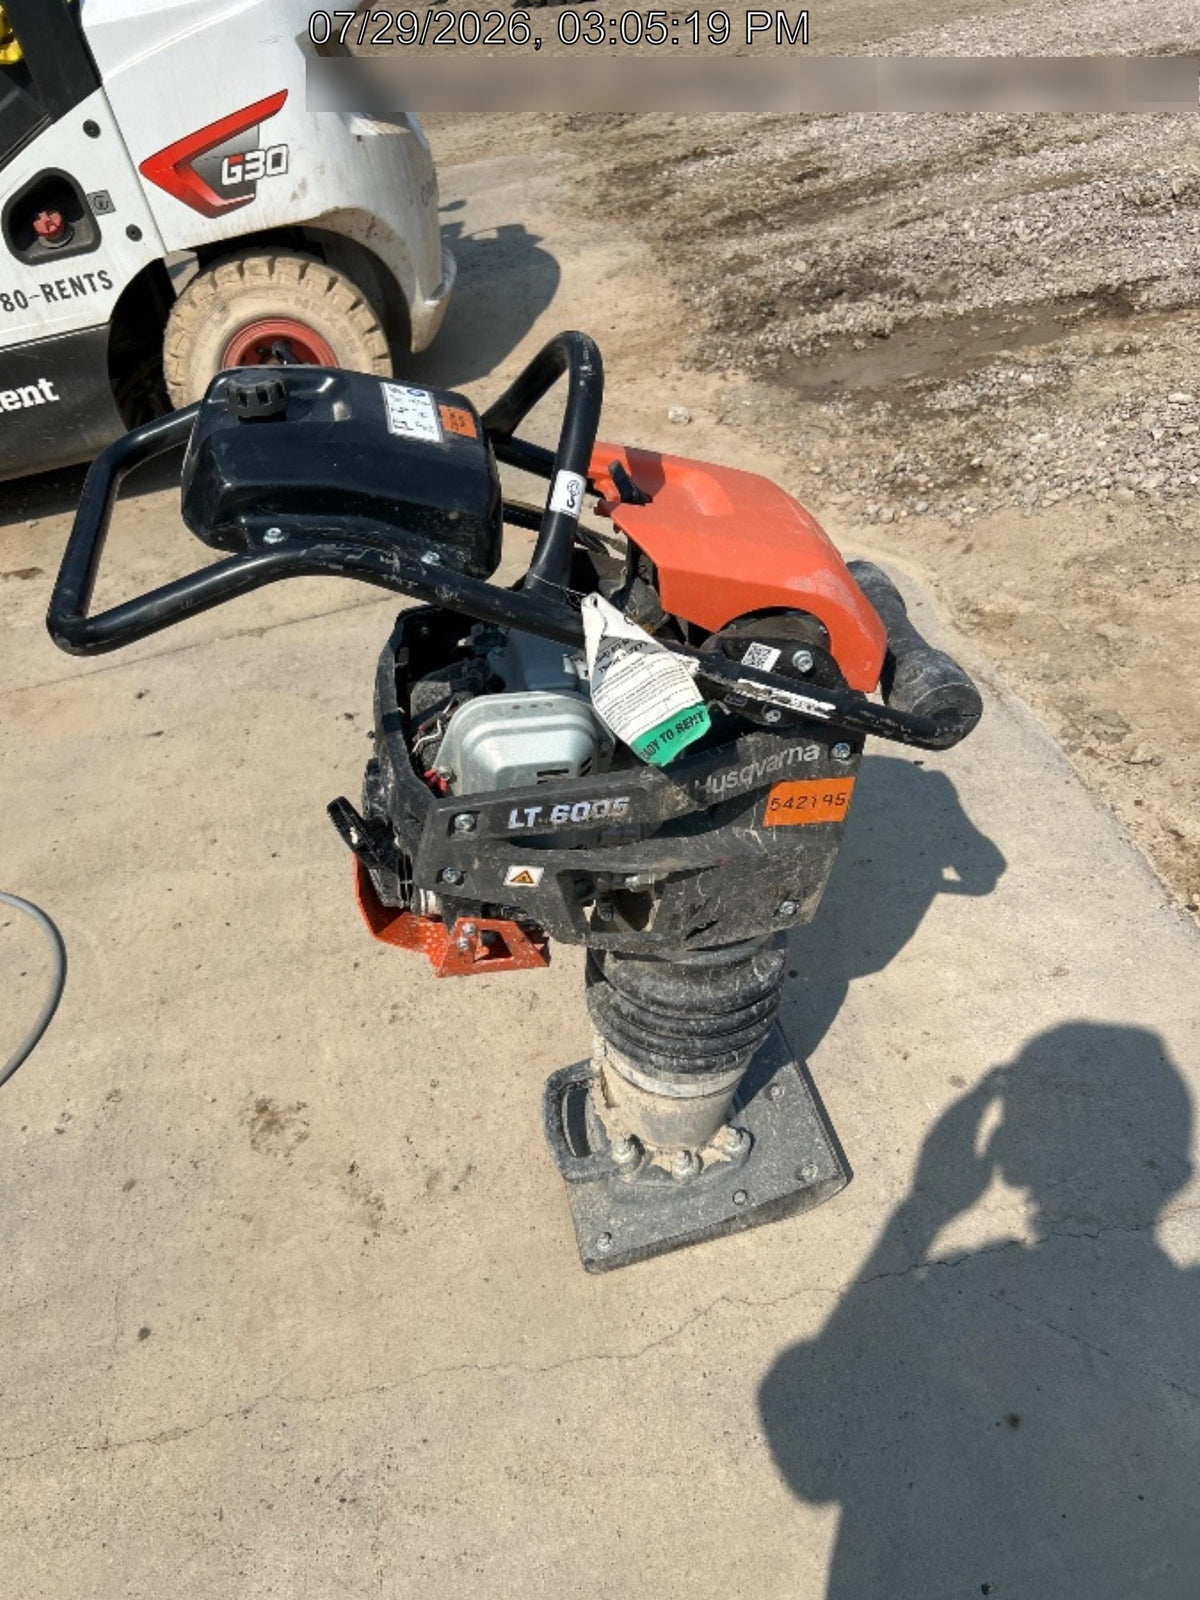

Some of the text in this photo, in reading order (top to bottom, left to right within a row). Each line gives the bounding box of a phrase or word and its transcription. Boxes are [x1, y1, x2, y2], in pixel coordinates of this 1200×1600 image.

[221, 143, 289, 186] G30
[0, 377, 60, 413] ent
[507, 796, 631, 830] LT 6005
